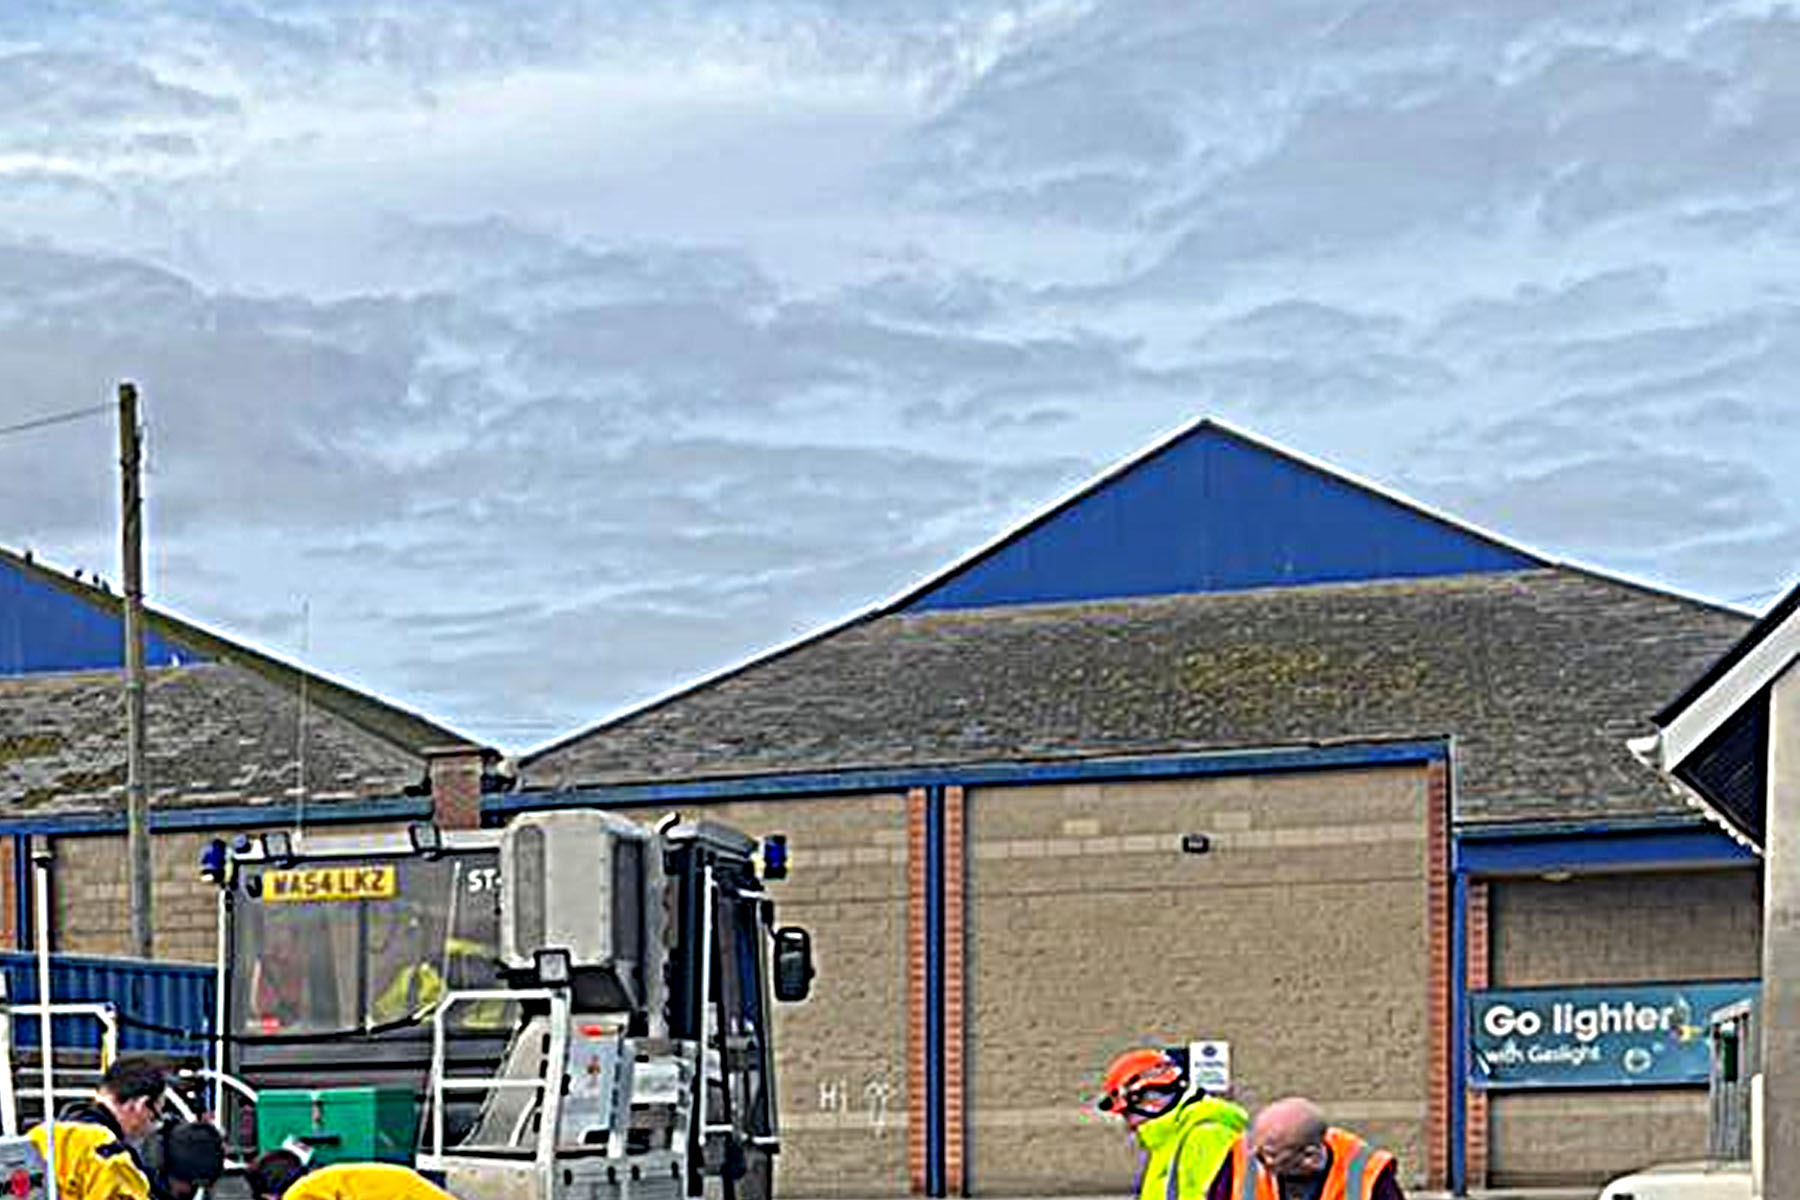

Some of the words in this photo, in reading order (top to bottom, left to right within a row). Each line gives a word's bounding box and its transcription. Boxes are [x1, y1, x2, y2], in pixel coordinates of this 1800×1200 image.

[339, 869, 385, 894] LKZ
[1485, 1005, 1541, 1036] Go
[1553, 1001, 1674, 1042] lighter
[1486, 1040, 1525, 1064] with
[1528, 1044, 1601, 1066] Gaslight
